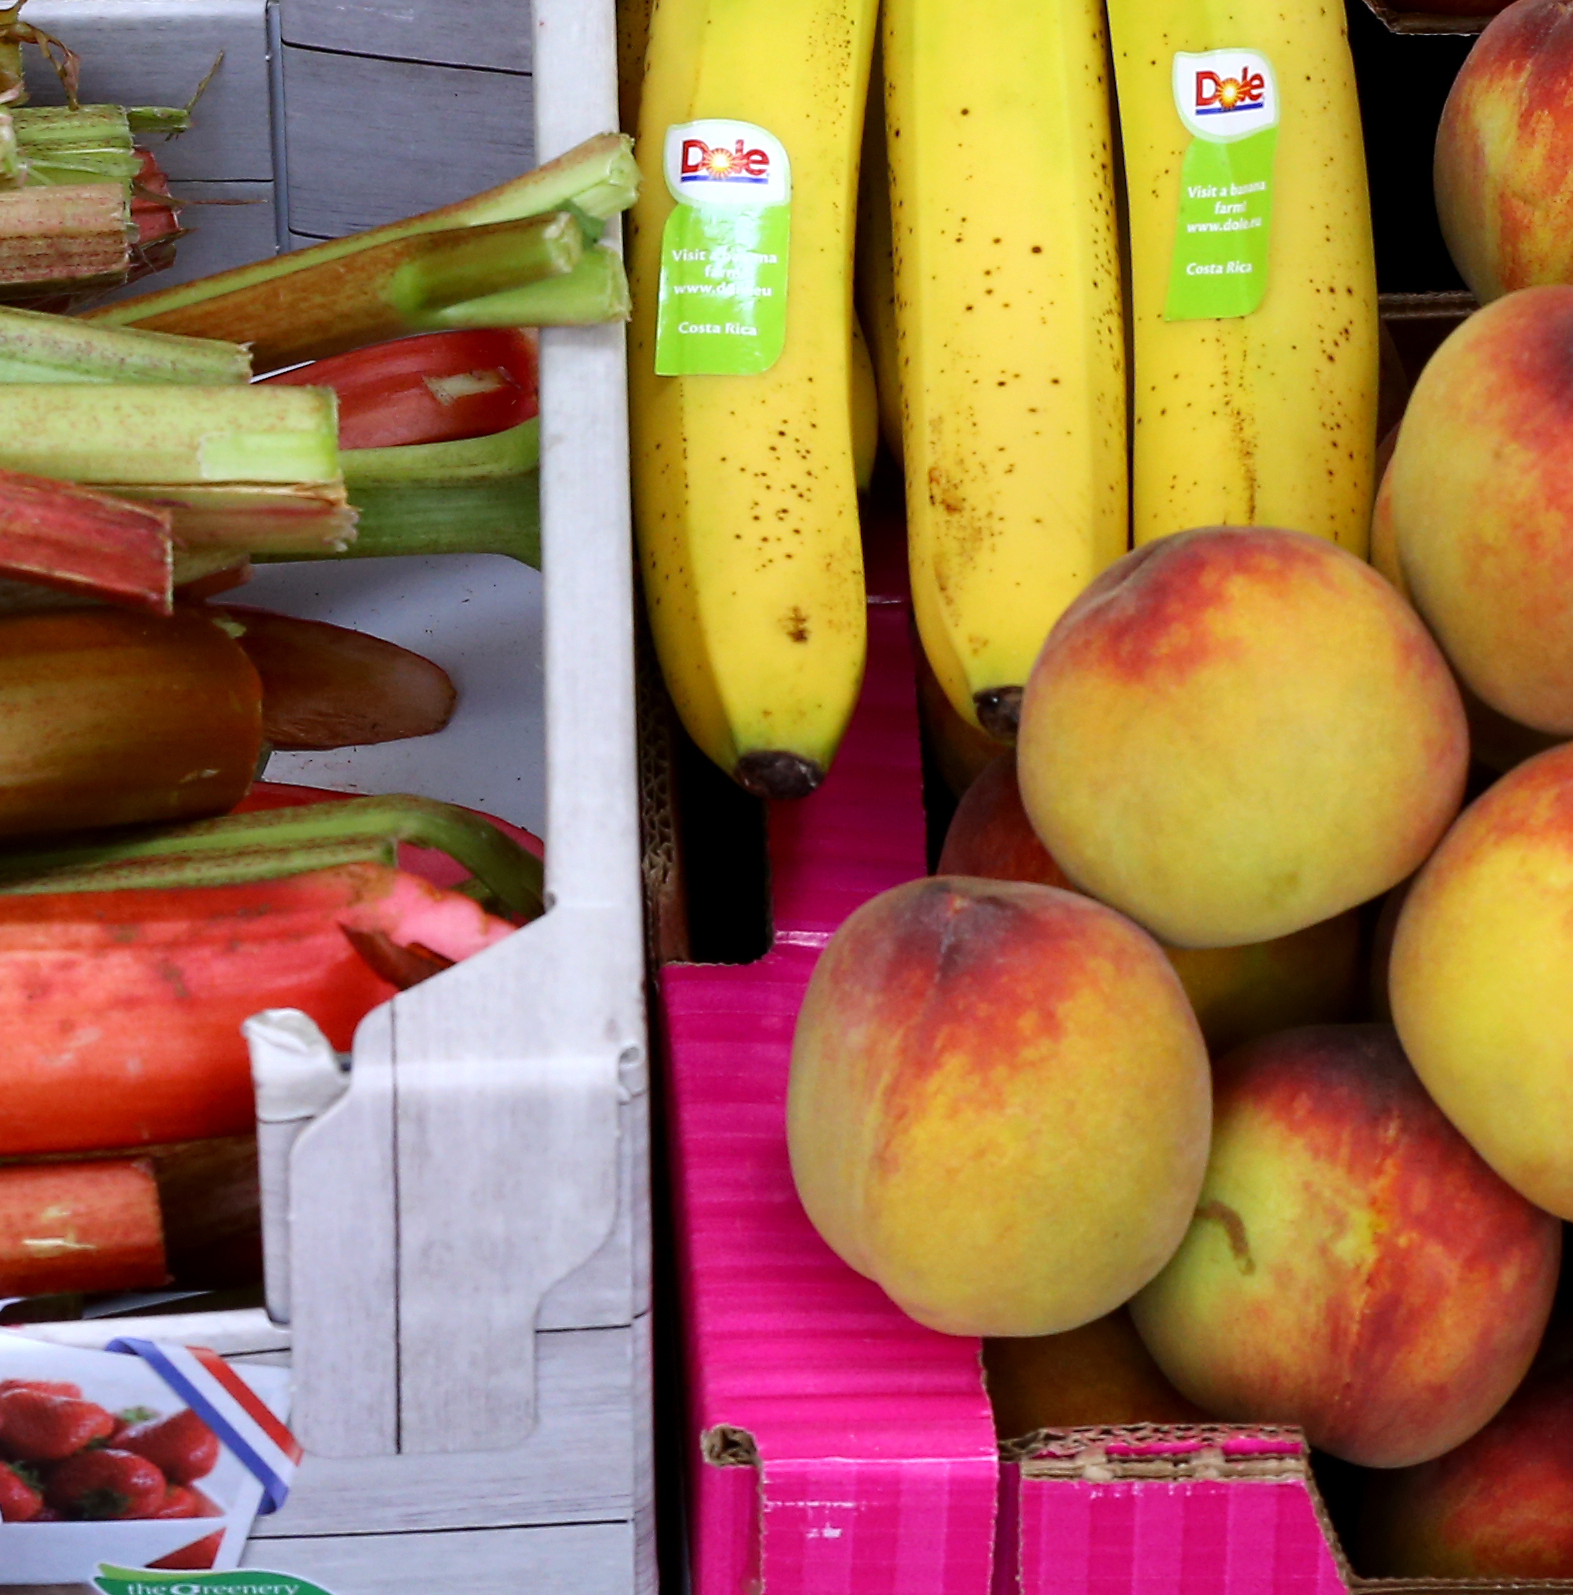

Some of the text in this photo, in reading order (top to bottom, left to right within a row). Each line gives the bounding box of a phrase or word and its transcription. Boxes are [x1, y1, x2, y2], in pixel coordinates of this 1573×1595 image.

[1195, 65, 1265, 109] Dole
[680, 138, 770, 177] Dole
[1187, 185, 1217, 198] Visit
[672, 248, 706, 261] Visit
[1186, 261, 1253, 275] Costa Rica
[678, 322, 758, 336] Costa Rica
